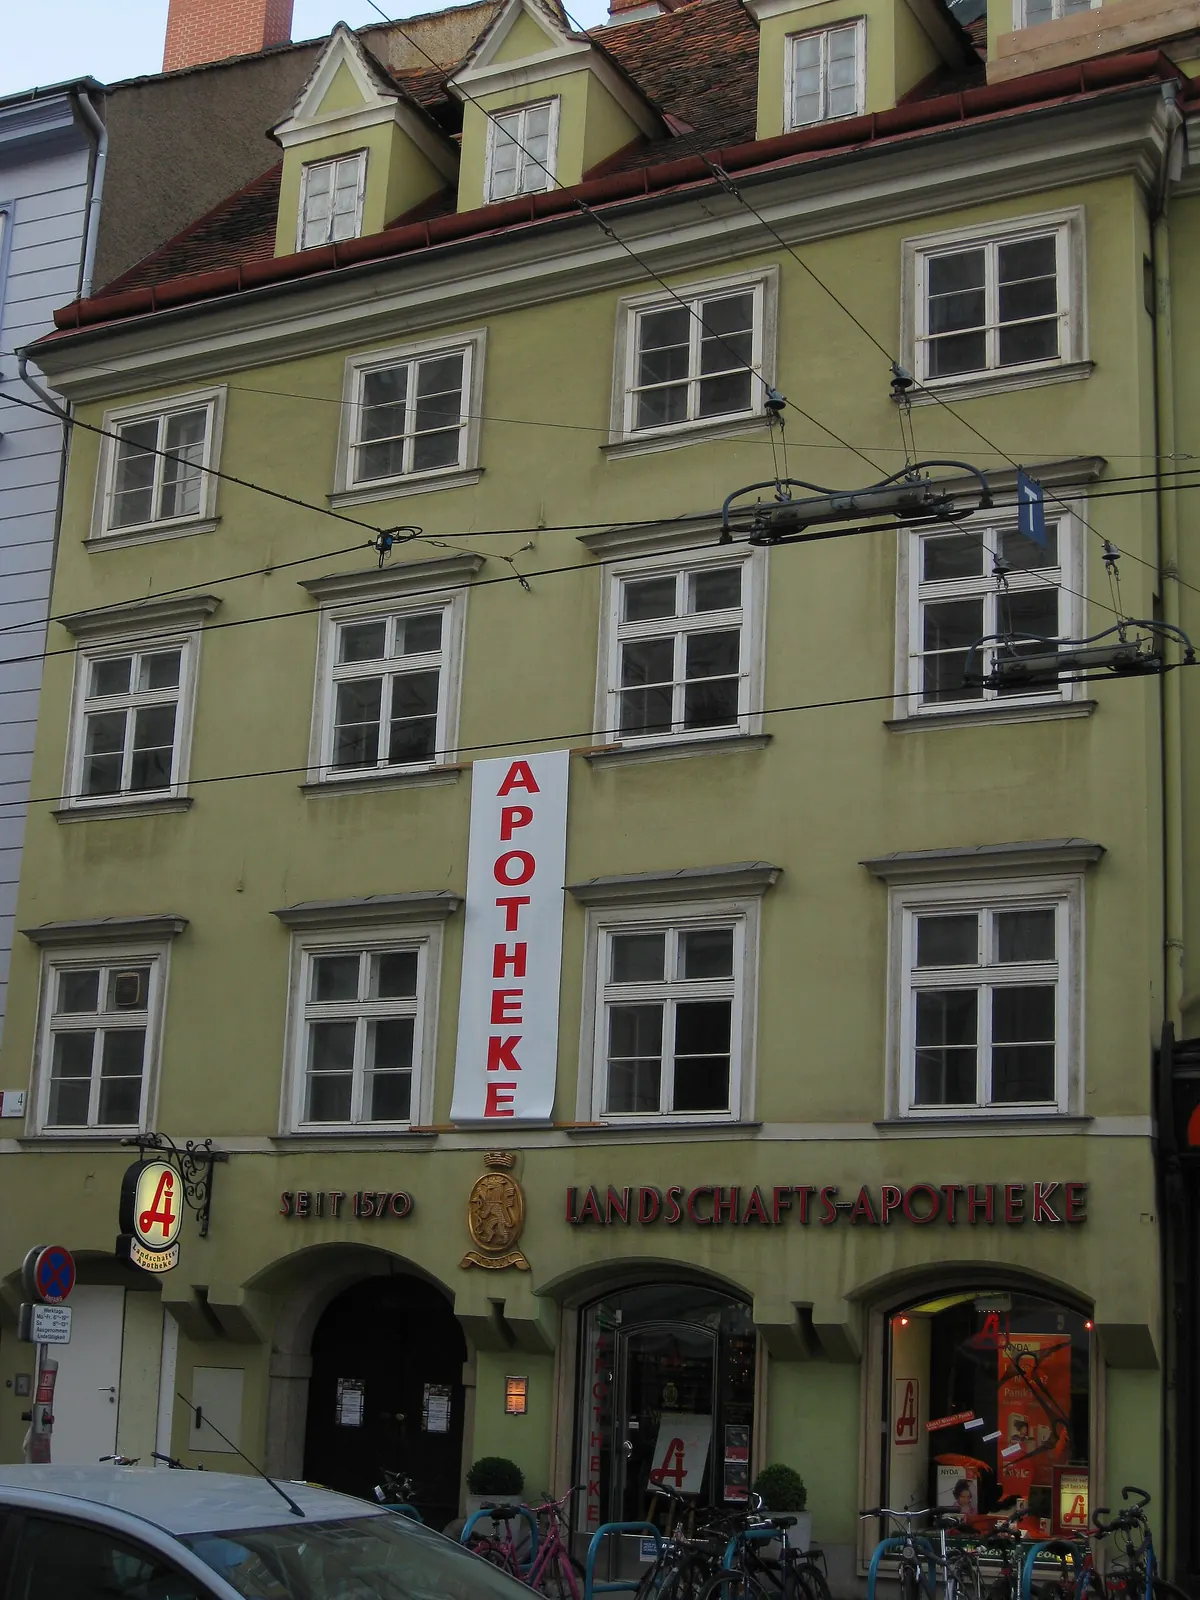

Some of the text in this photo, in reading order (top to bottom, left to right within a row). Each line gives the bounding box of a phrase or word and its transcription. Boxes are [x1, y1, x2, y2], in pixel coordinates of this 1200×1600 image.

[483, 760, 541, 1118] APOTHEKE
[279, 1190, 412, 1218] SEIT 1570
[564, 1180, 1088, 1226] LANDSCHAFTS-APOTHEKE
[136, 1256, 172, 1270] Apotheke
[587, 1335, 607, 1522] APOTHEKE
